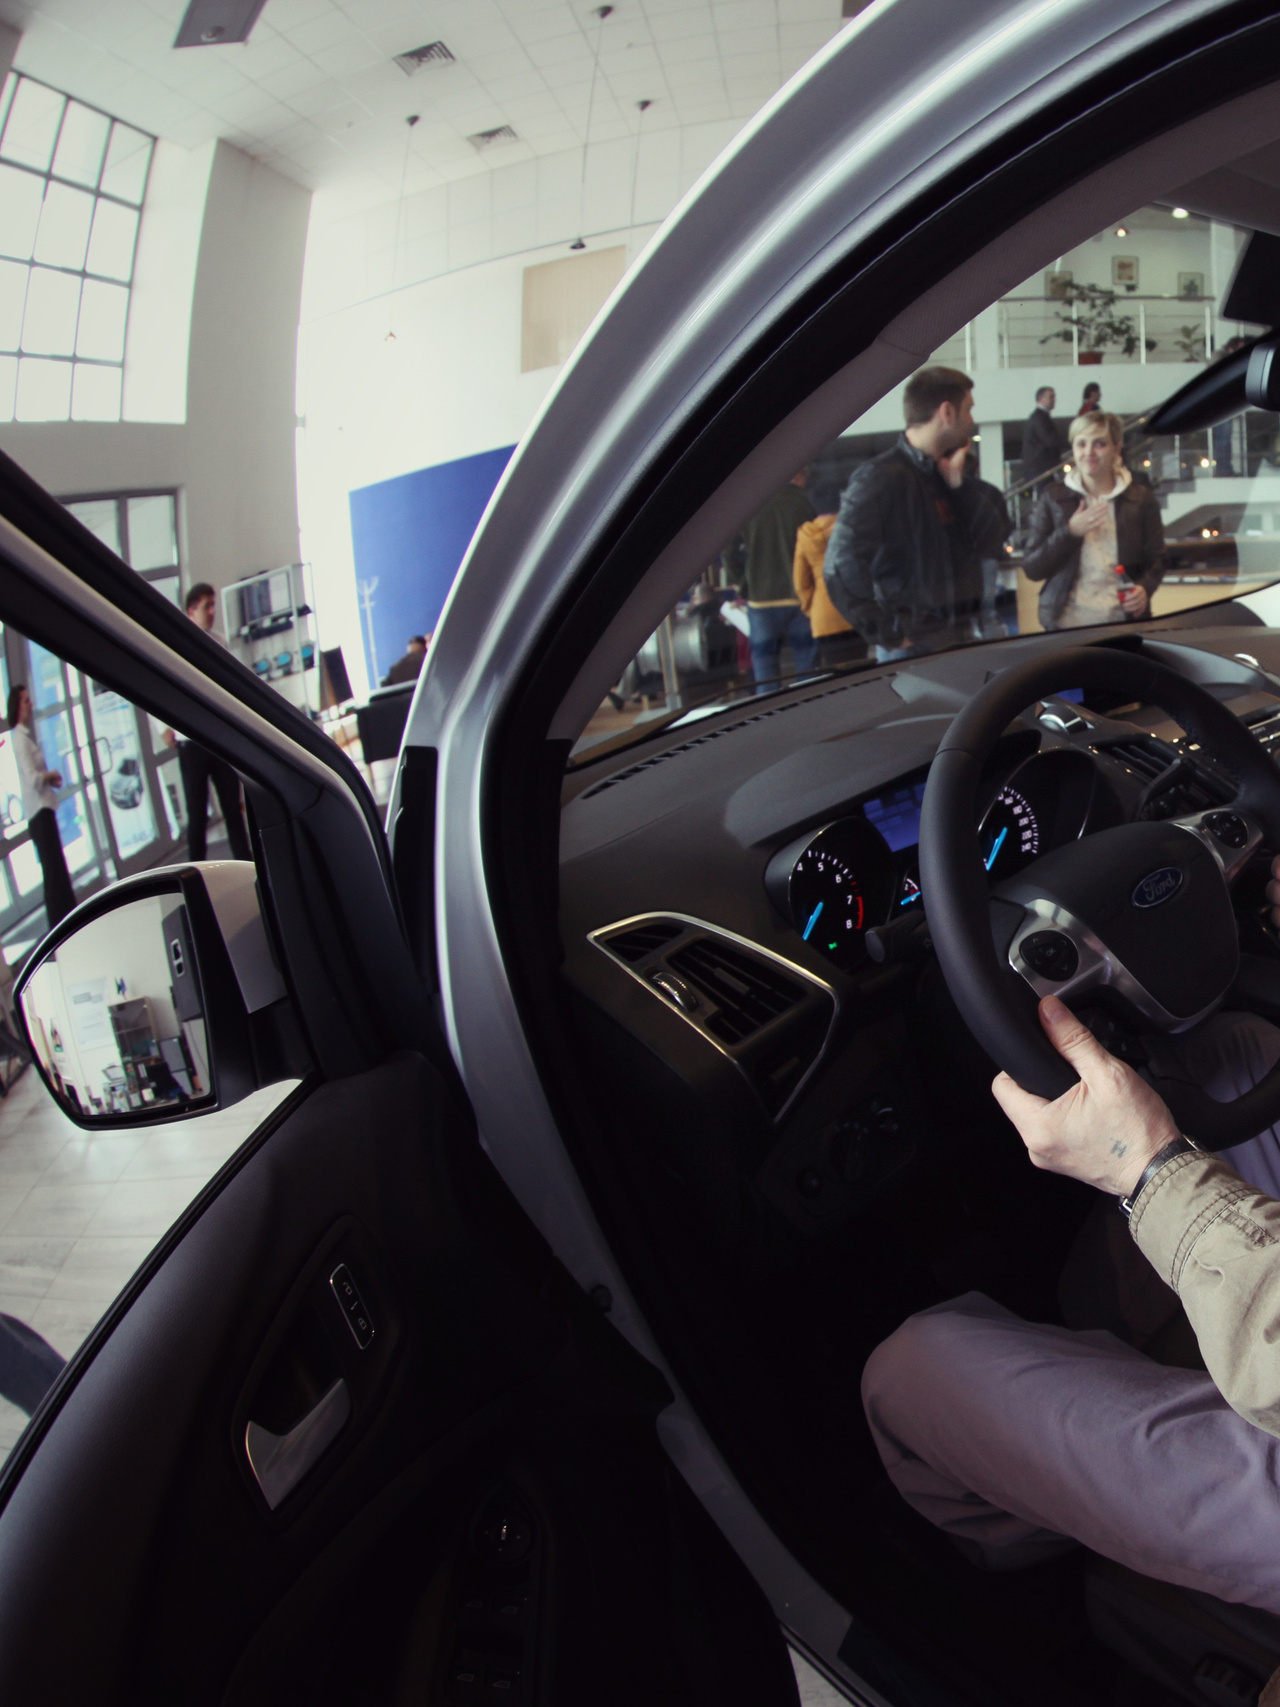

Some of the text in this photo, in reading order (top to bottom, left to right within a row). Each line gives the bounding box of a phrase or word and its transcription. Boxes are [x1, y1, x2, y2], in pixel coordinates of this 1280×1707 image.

[797, 862, 803, 871] 4
[817, 862, 824, 872] 5
[835, 874, 842, 884] 6
[1142, 872, 1176, 901] Ford
[847, 895, 852, 905] 7
[846, 919, 852, 929] 8
